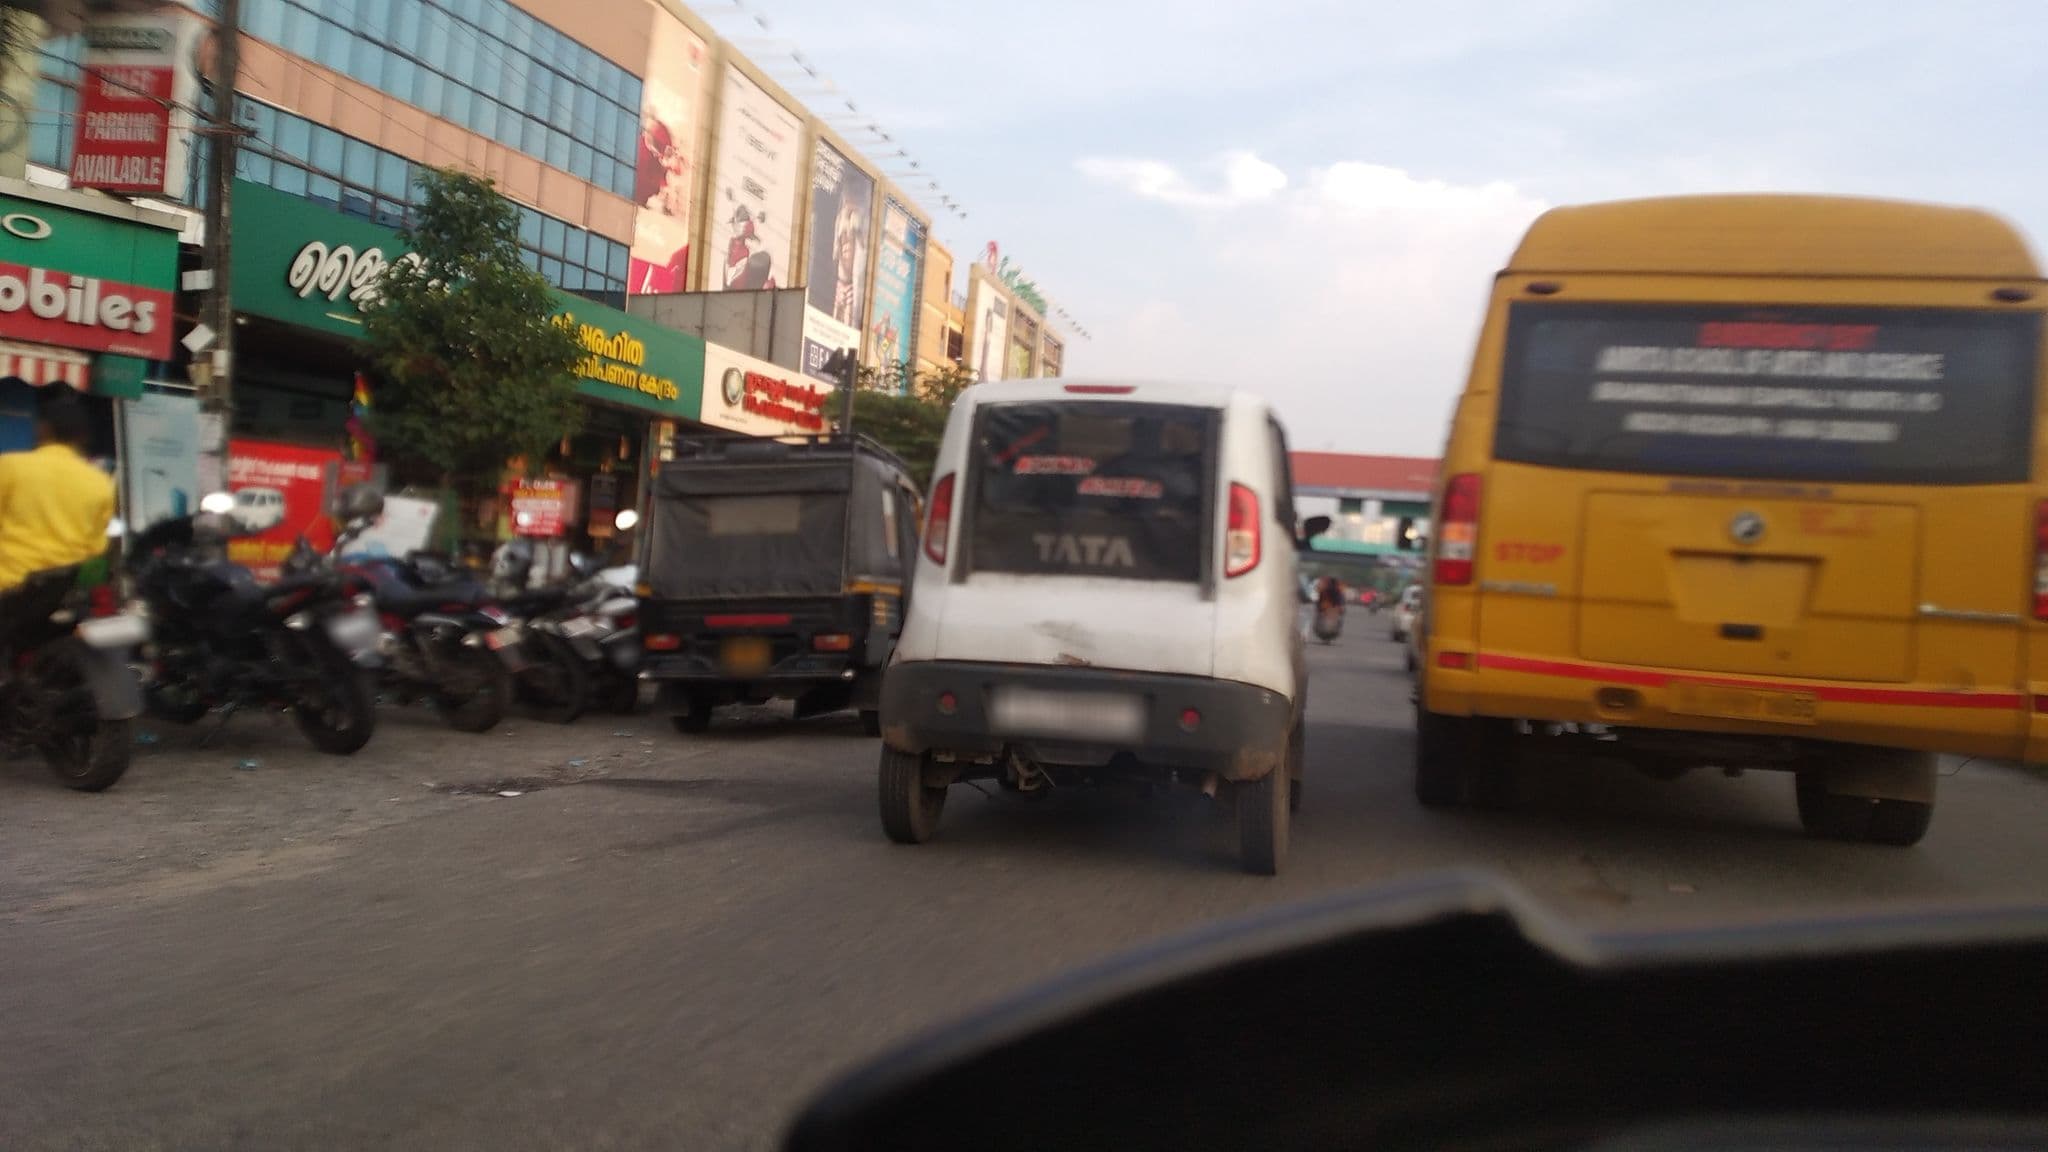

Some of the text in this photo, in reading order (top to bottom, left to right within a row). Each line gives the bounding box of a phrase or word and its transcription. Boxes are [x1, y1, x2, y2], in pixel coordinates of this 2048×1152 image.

[85, 112, 159, 143] PARKING
[75, 155, 161, 185] AVAILABLE
[1033, 532, 1136, 568] TATA
